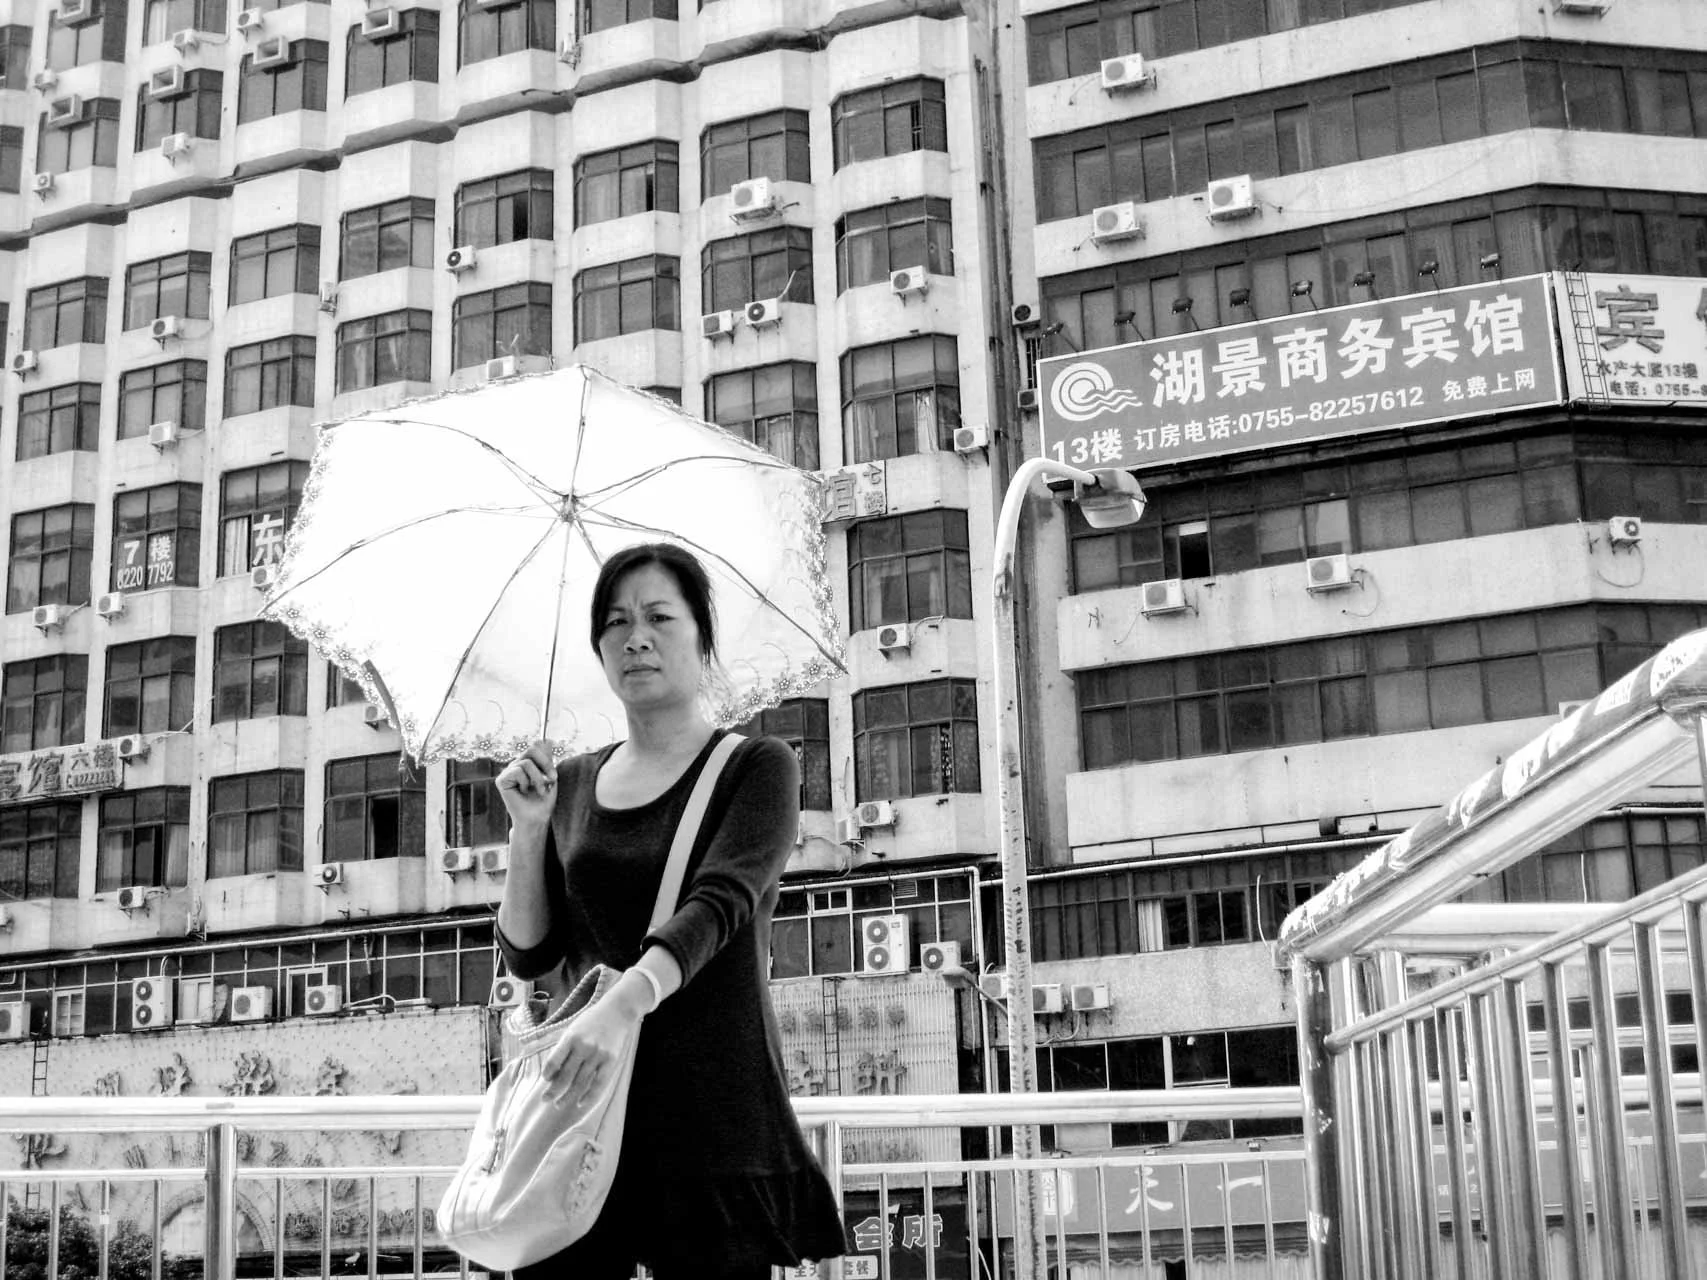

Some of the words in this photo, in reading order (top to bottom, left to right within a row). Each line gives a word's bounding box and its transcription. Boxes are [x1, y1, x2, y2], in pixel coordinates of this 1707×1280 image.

[1150, 293, 1524, 408] 湖景商务宾馆
[1442, 367, 1536, 402] 免费上网
[1052, 428, 1123, 465] 13楼
